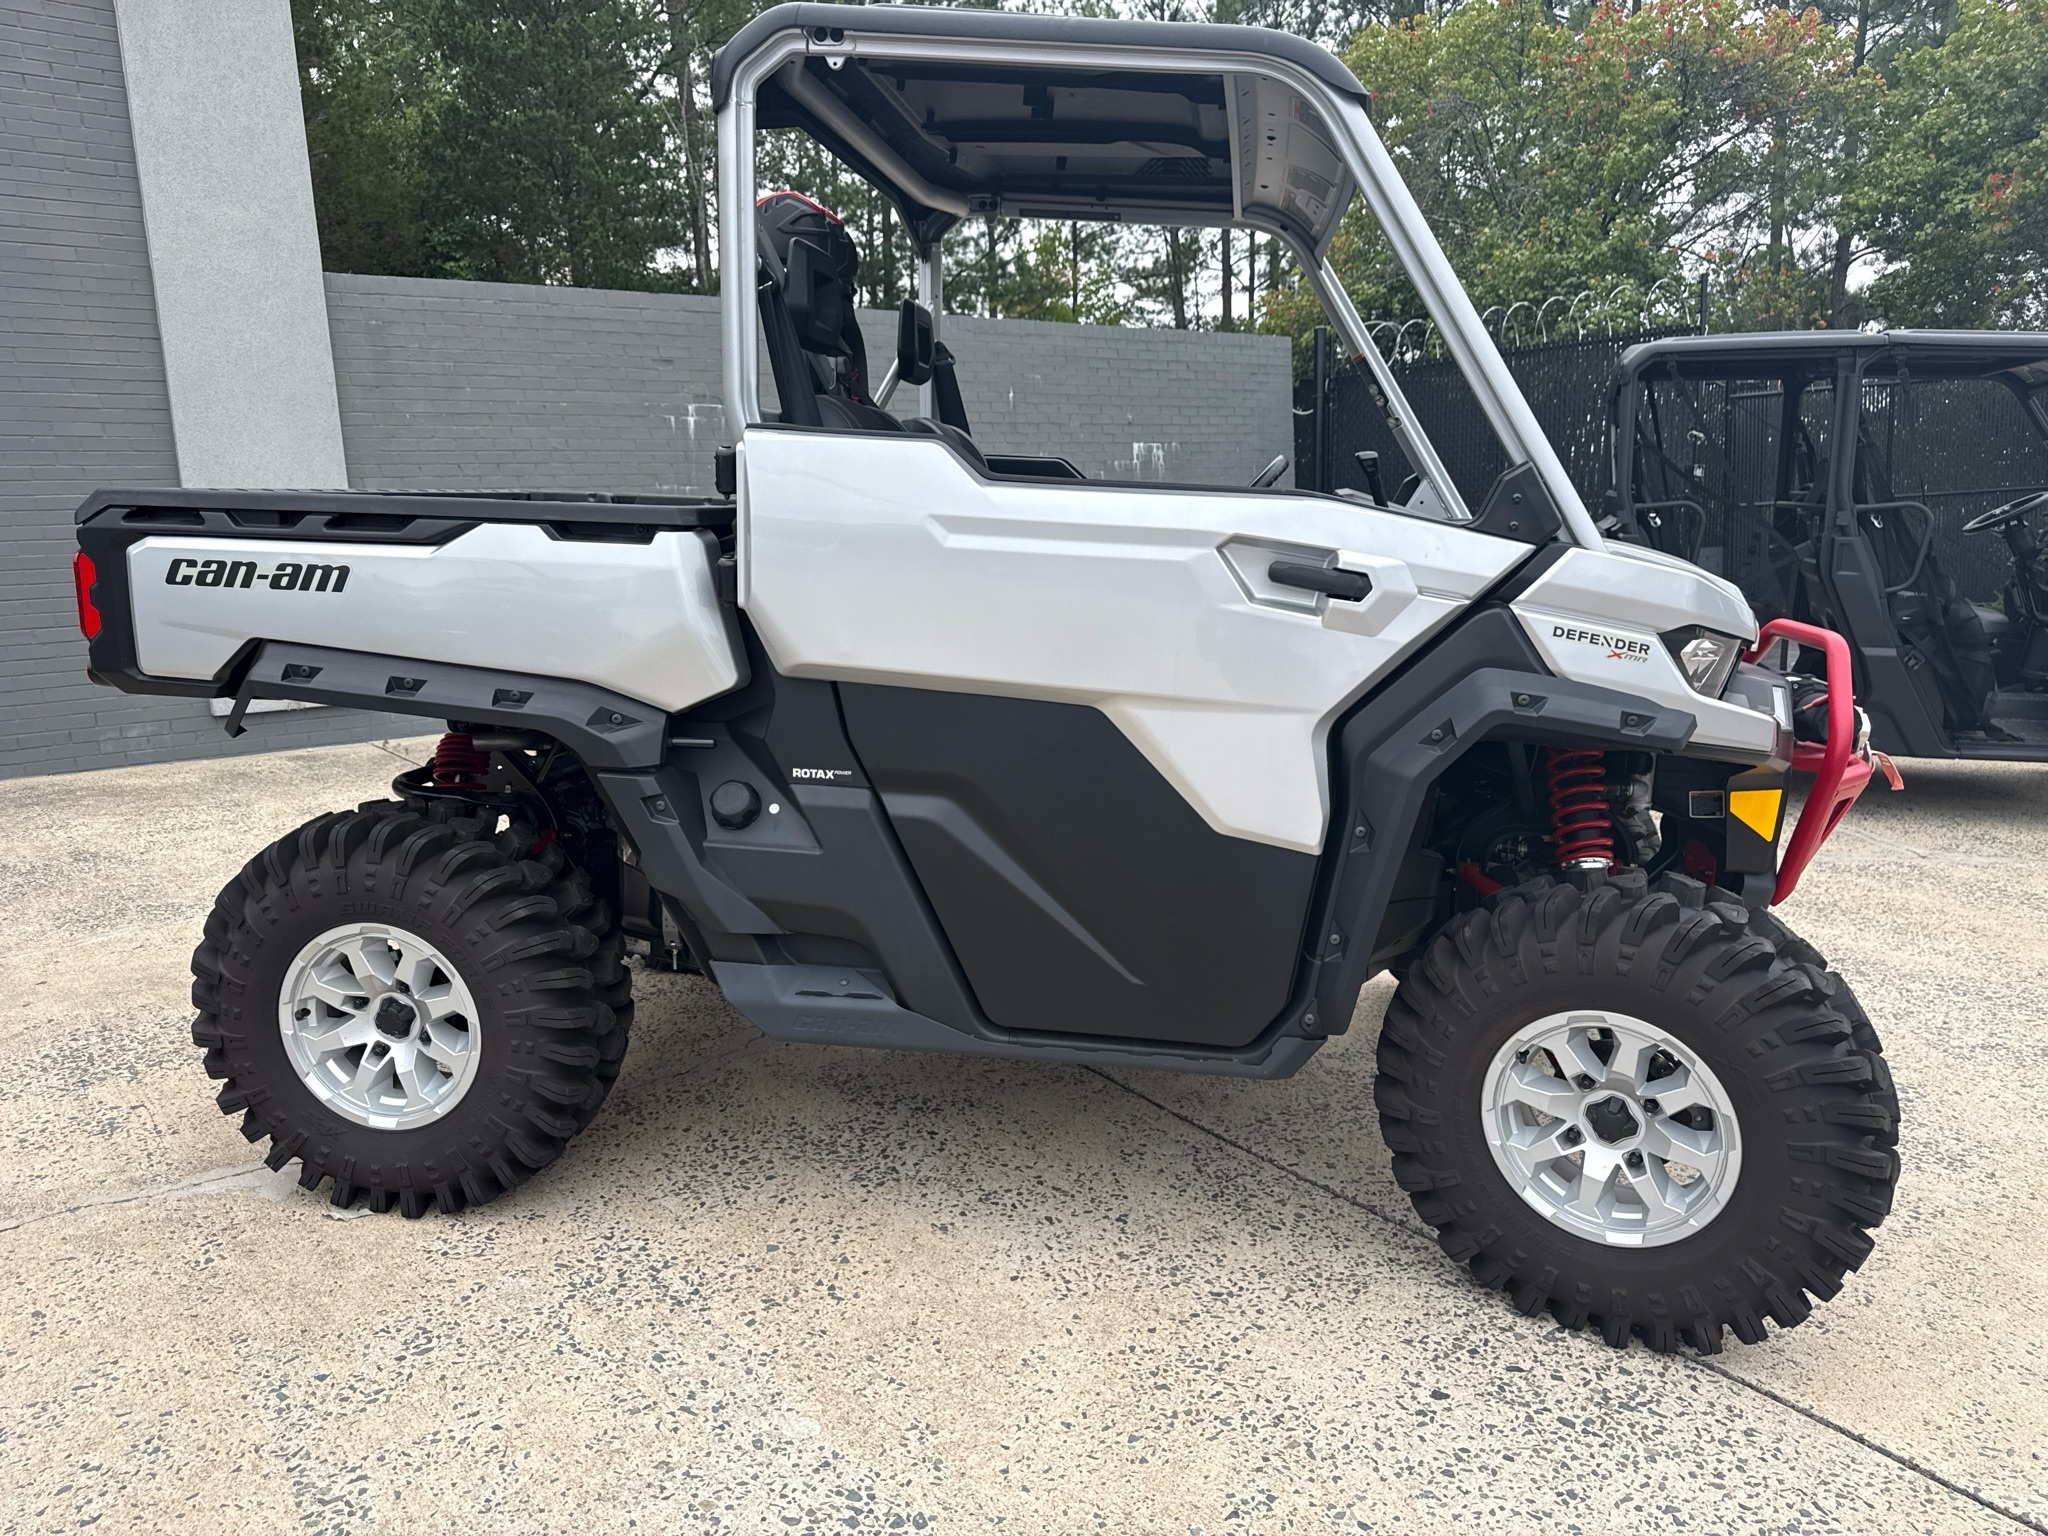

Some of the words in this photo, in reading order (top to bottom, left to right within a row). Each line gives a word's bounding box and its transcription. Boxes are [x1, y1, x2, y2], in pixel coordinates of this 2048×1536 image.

[164, 558, 351, 593] can-am
[1552, 625, 1651, 656] DEFENDER
[792, 767, 835, 780] ROTAX
